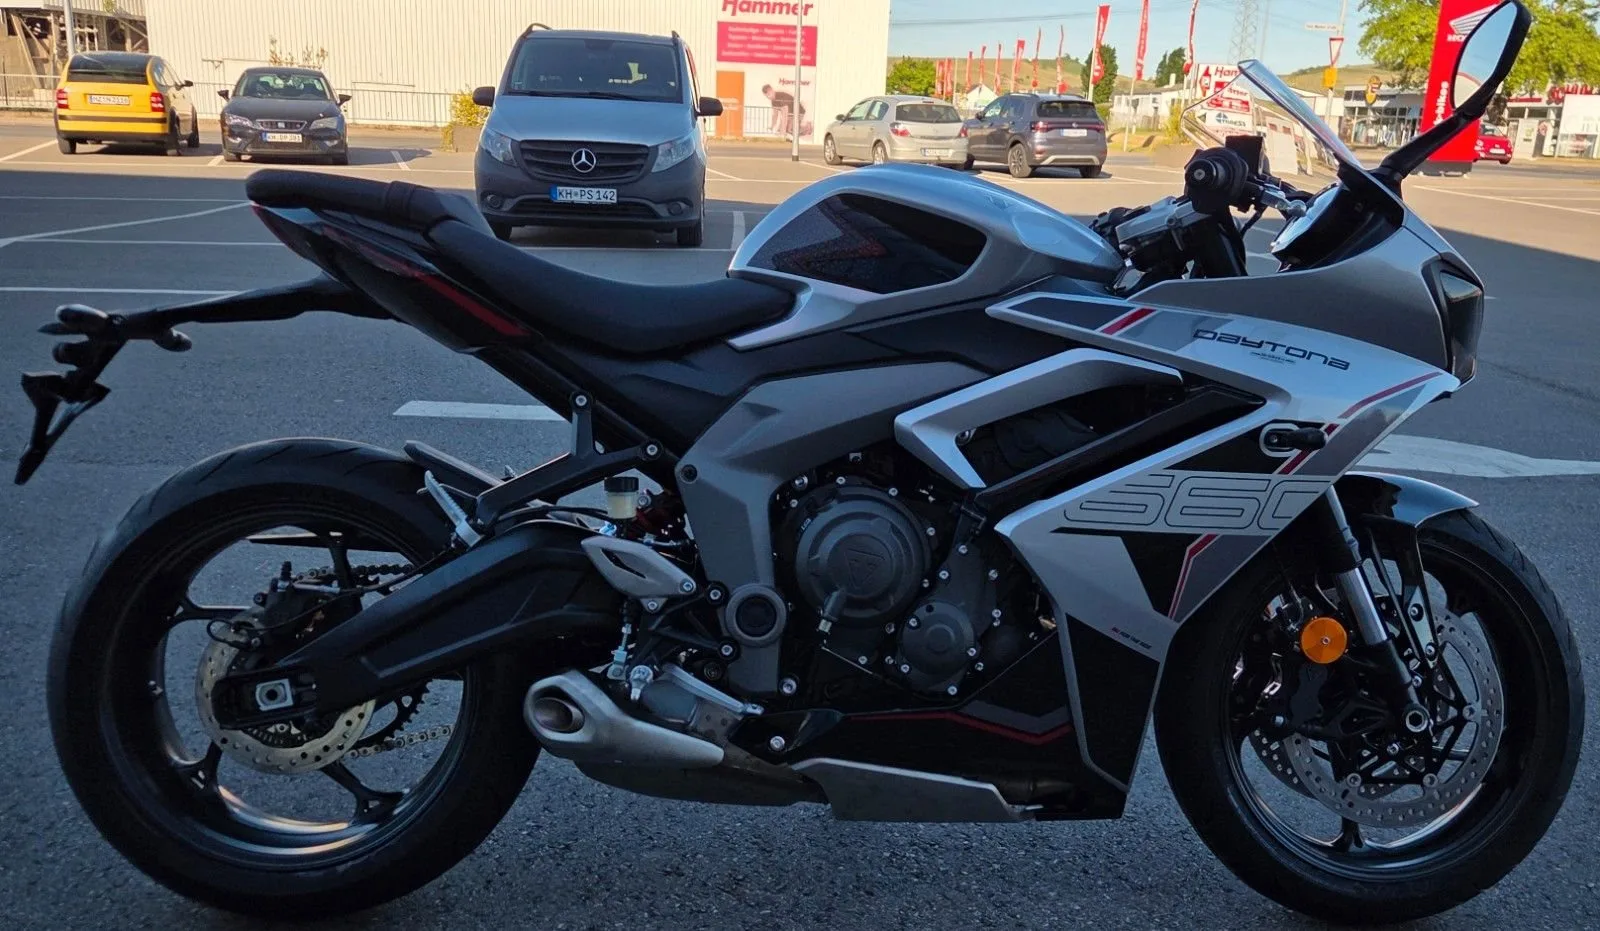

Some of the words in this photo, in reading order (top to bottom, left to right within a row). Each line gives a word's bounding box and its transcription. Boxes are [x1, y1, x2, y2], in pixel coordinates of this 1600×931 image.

[722, 0, 813, 16] Hammer
[779, 77, 810, 86] Hamer
[558, 189, 573, 199] KH
[579, 189, 594, 200] PS
[595, 190, 616, 201] 142
